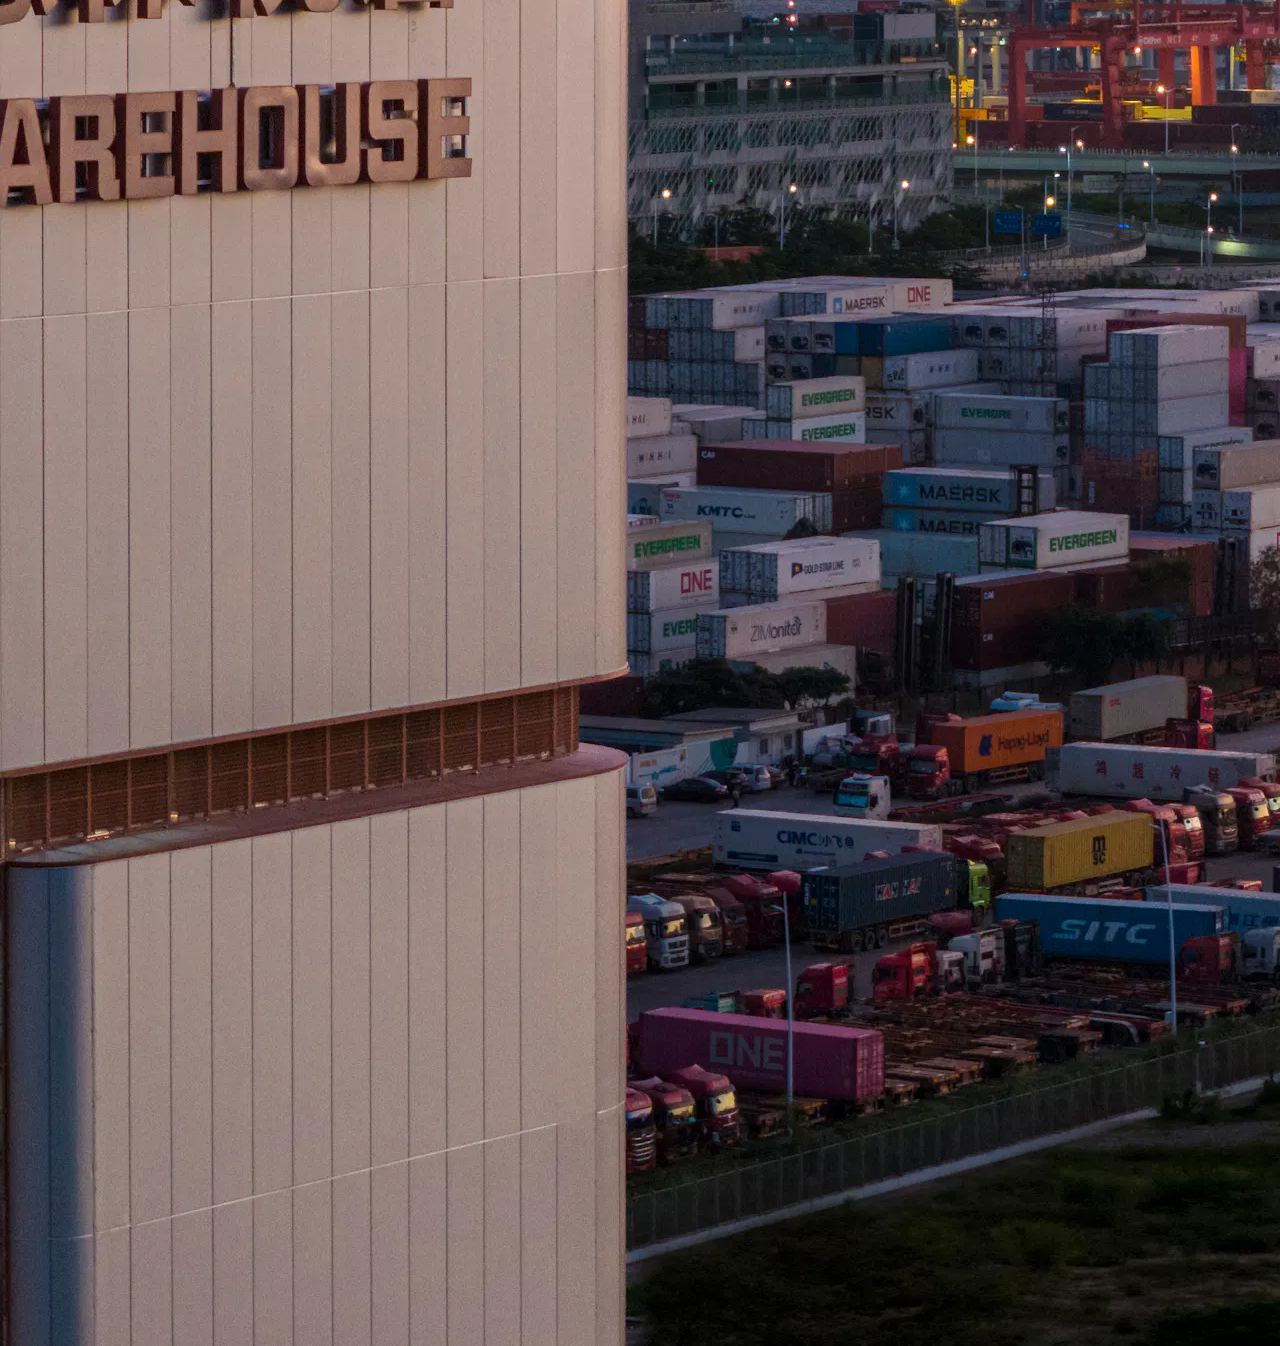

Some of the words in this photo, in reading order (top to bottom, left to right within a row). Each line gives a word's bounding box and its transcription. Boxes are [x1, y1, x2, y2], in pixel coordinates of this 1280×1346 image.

[845, 295, 885, 311] MAERSK
[907, 285, 931, 303] ONE
[801, 388, 856, 407] EVERGREEN
[865, 406, 895, 420] RSK
[801, 422, 856, 441] EVERGREEN
[919, 484, 1001, 503] MAERSK
[696, 504, 743, 518] KMTC
[634, 534, 700, 558] EVERGREEN
[1049, 529, 1117, 553] EVERGREEN
[804, 562, 818, 574] GOLD
[833, 560, 844, 571] LINE
[680, 568, 712, 594] ONE
[750, 617, 802, 642] ZIMonitor
[998, 730, 1049, 751] Hapag-Lloyd
[777, 830, 817, 846] CIMC
[1052, 919, 1156, 944] SITC
[710, 1030, 784, 1071] ONE
